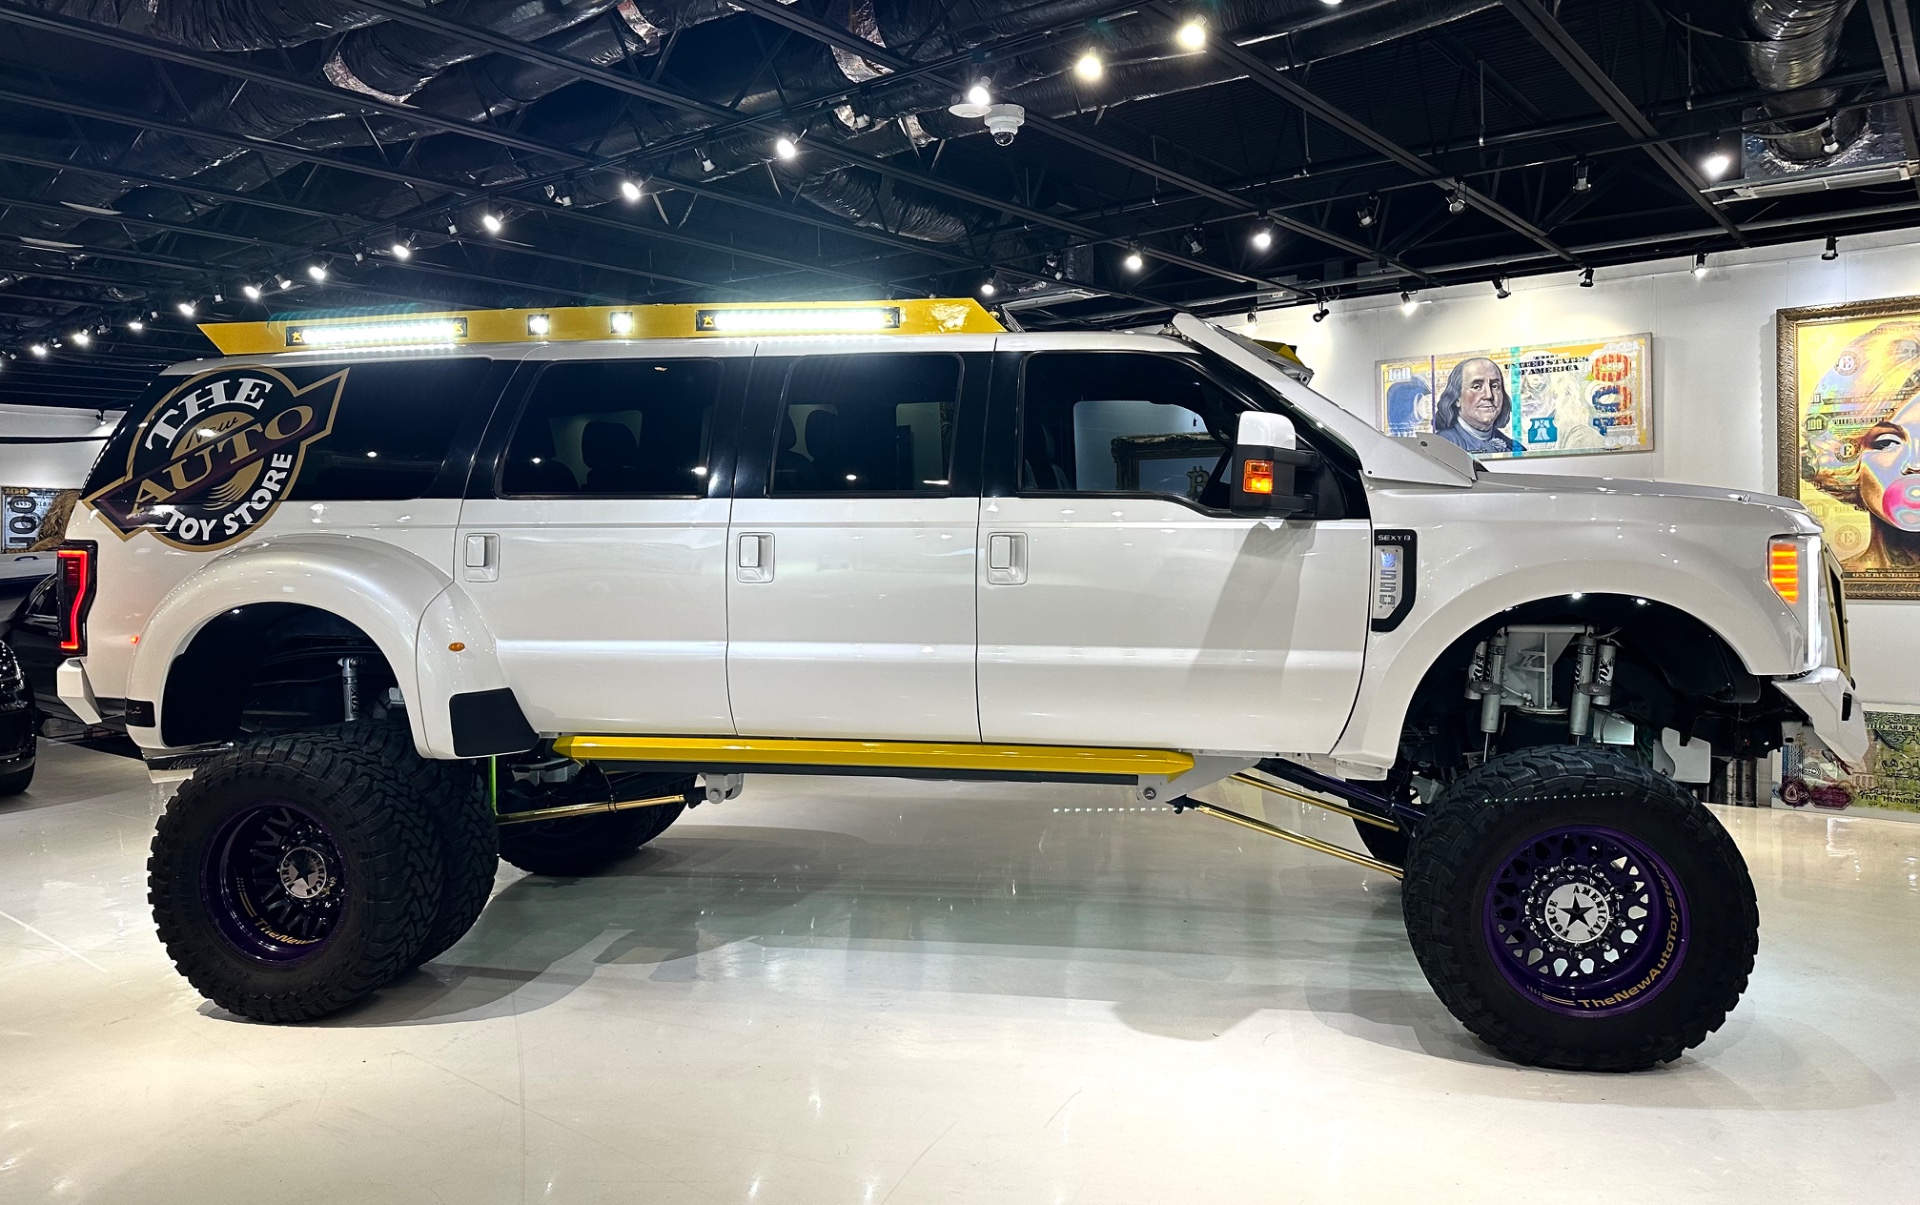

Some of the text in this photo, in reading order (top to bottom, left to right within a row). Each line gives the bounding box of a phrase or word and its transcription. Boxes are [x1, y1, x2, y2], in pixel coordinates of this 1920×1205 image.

[145, 377, 273, 450] THE
[126, 405, 313, 520] AUTO
[164, 453, 293, 541] TOY STORE
[1547, 899, 1571, 938] FORCE
[1573, 885, 1607, 938] AMERICAN
